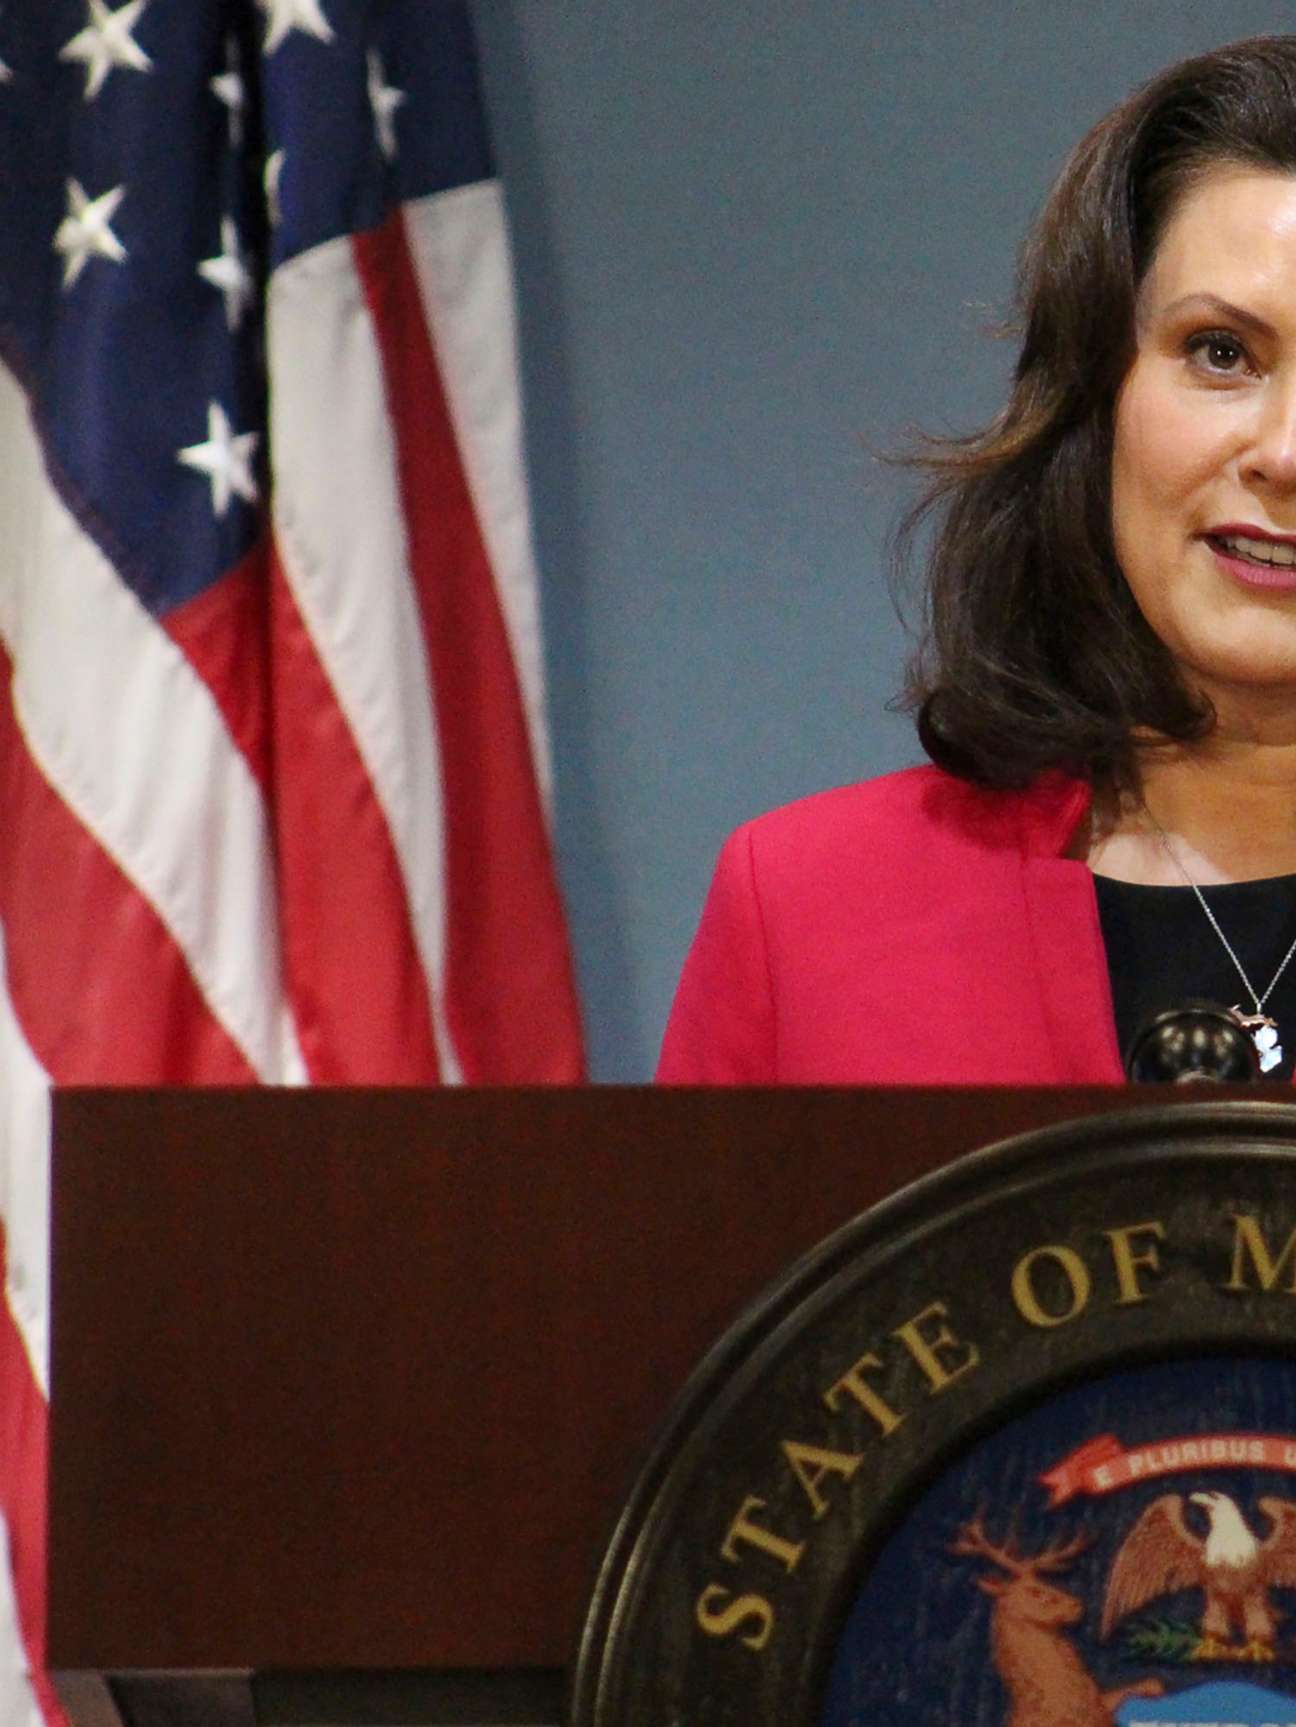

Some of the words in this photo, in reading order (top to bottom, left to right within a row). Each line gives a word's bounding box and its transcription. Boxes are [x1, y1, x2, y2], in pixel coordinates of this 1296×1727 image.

[697, 1302, 981, 1651] STATE
[1011, 1221, 1167, 1328] OF
[1091, 1465, 1111, 1489] E
[1127, 1440, 1265, 1478] PLURIBUS
